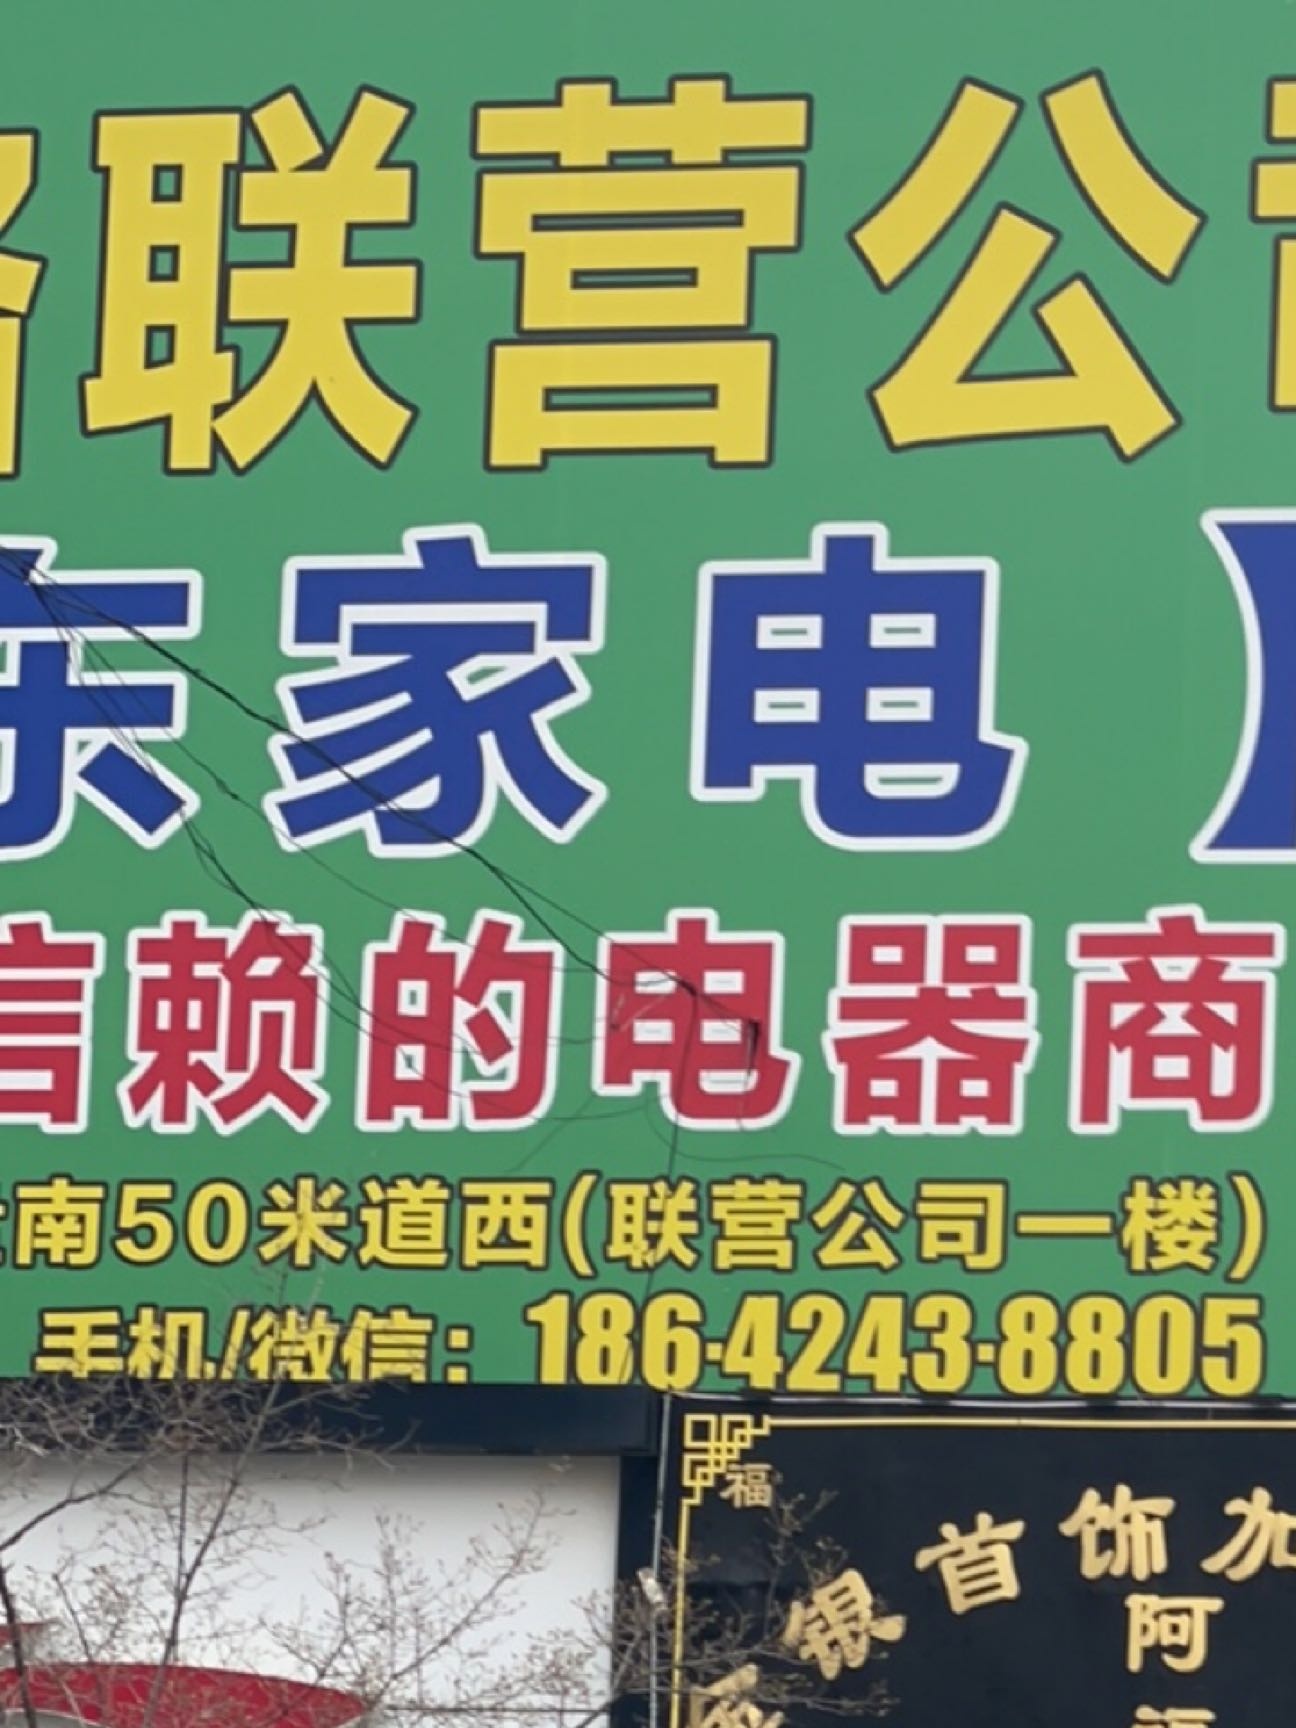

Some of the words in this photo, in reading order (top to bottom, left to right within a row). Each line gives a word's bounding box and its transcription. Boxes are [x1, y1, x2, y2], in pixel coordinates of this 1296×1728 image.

[0, 1173, 1266, 1280] 南50米道西(联营公司一楼)
[719, 1463, 773, 1508] 福
